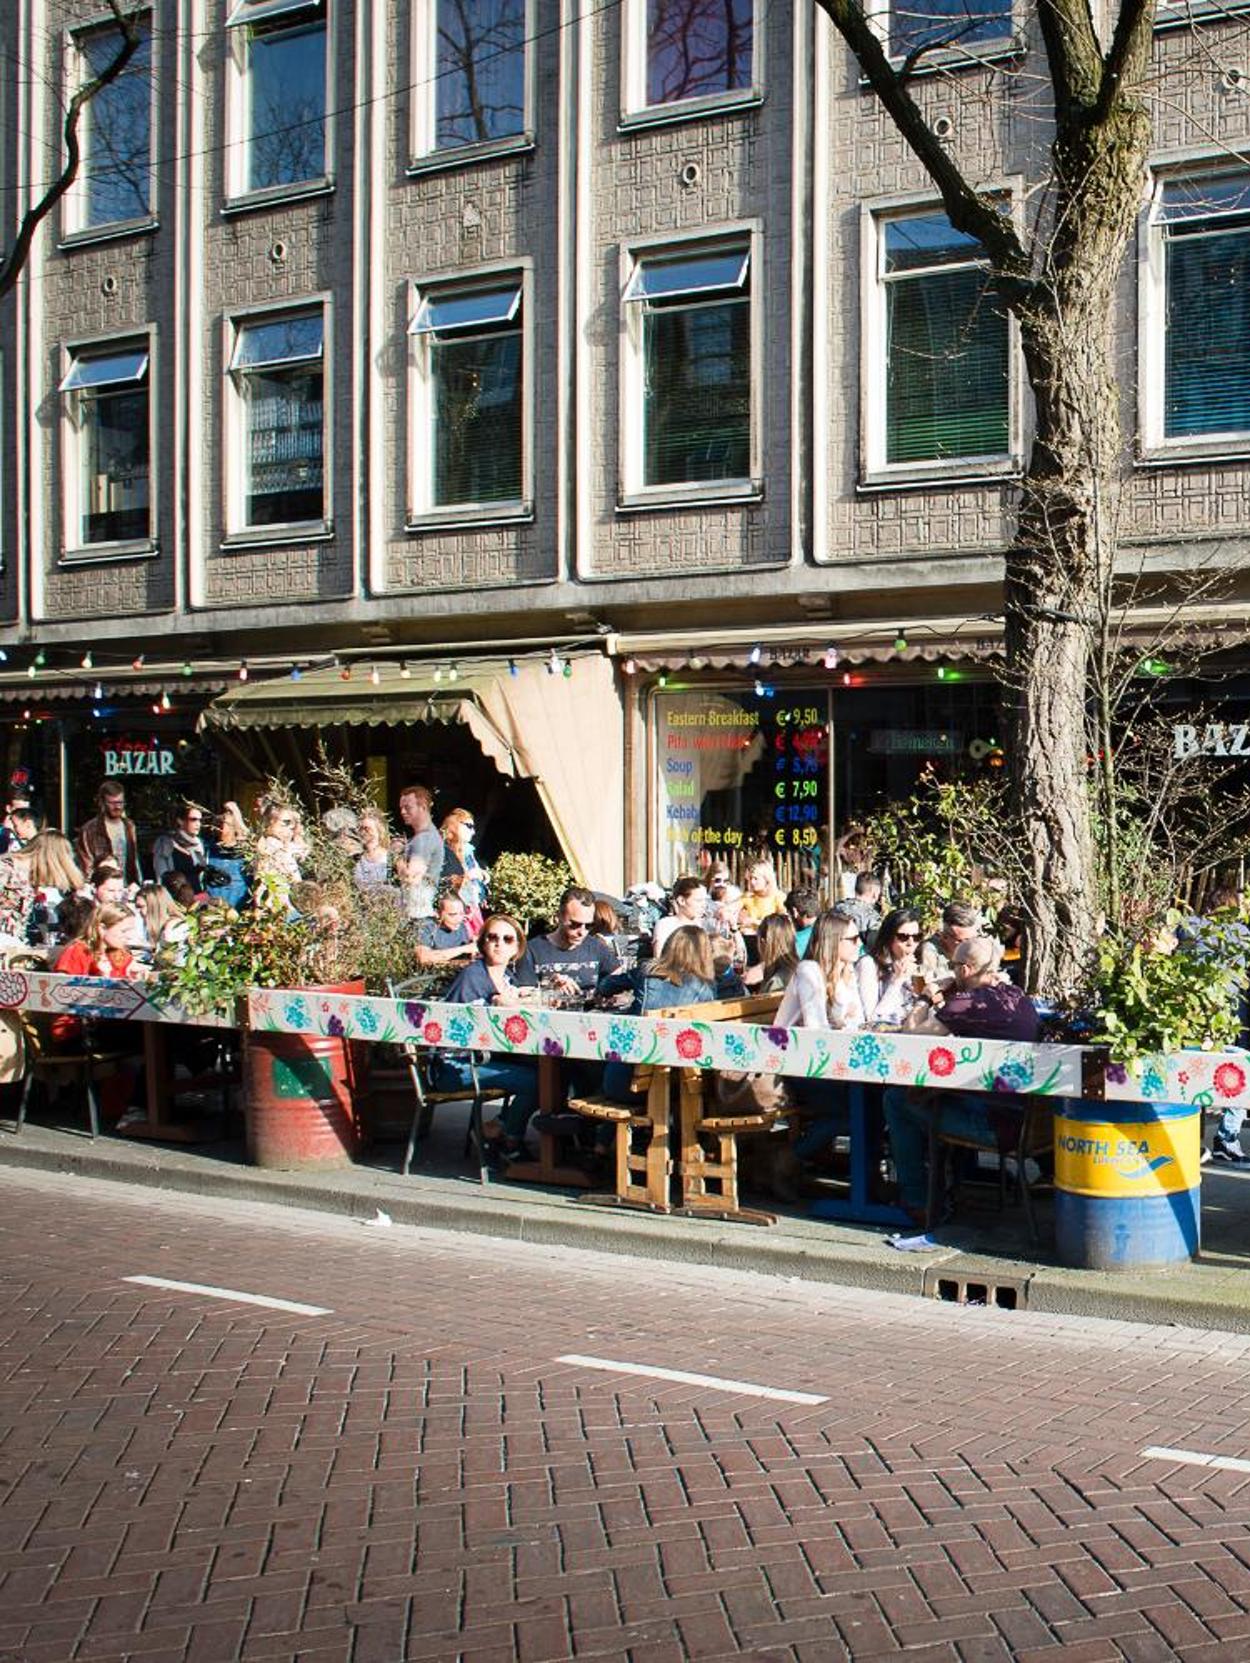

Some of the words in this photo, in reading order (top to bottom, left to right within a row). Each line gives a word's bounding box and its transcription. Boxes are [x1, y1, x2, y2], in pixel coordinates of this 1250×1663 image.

[667, 711, 706, 726] Eastern
[708, 709, 759, 726] Breakfast
[793, 708, 817, 726] 9,50
[104, 750, 177, 776] BAZAR
[666, 757, 693, 776] Soup
[792, 780, 817, 800] 7,90
[704, 827, 721, 844] the
[723, 827, 743, 848] day
[793, 827, 818, 848] 8,50
[1057, 1135, 1109, 1156] NORTH
[1117, 1140, 1149, 1157] SEA
